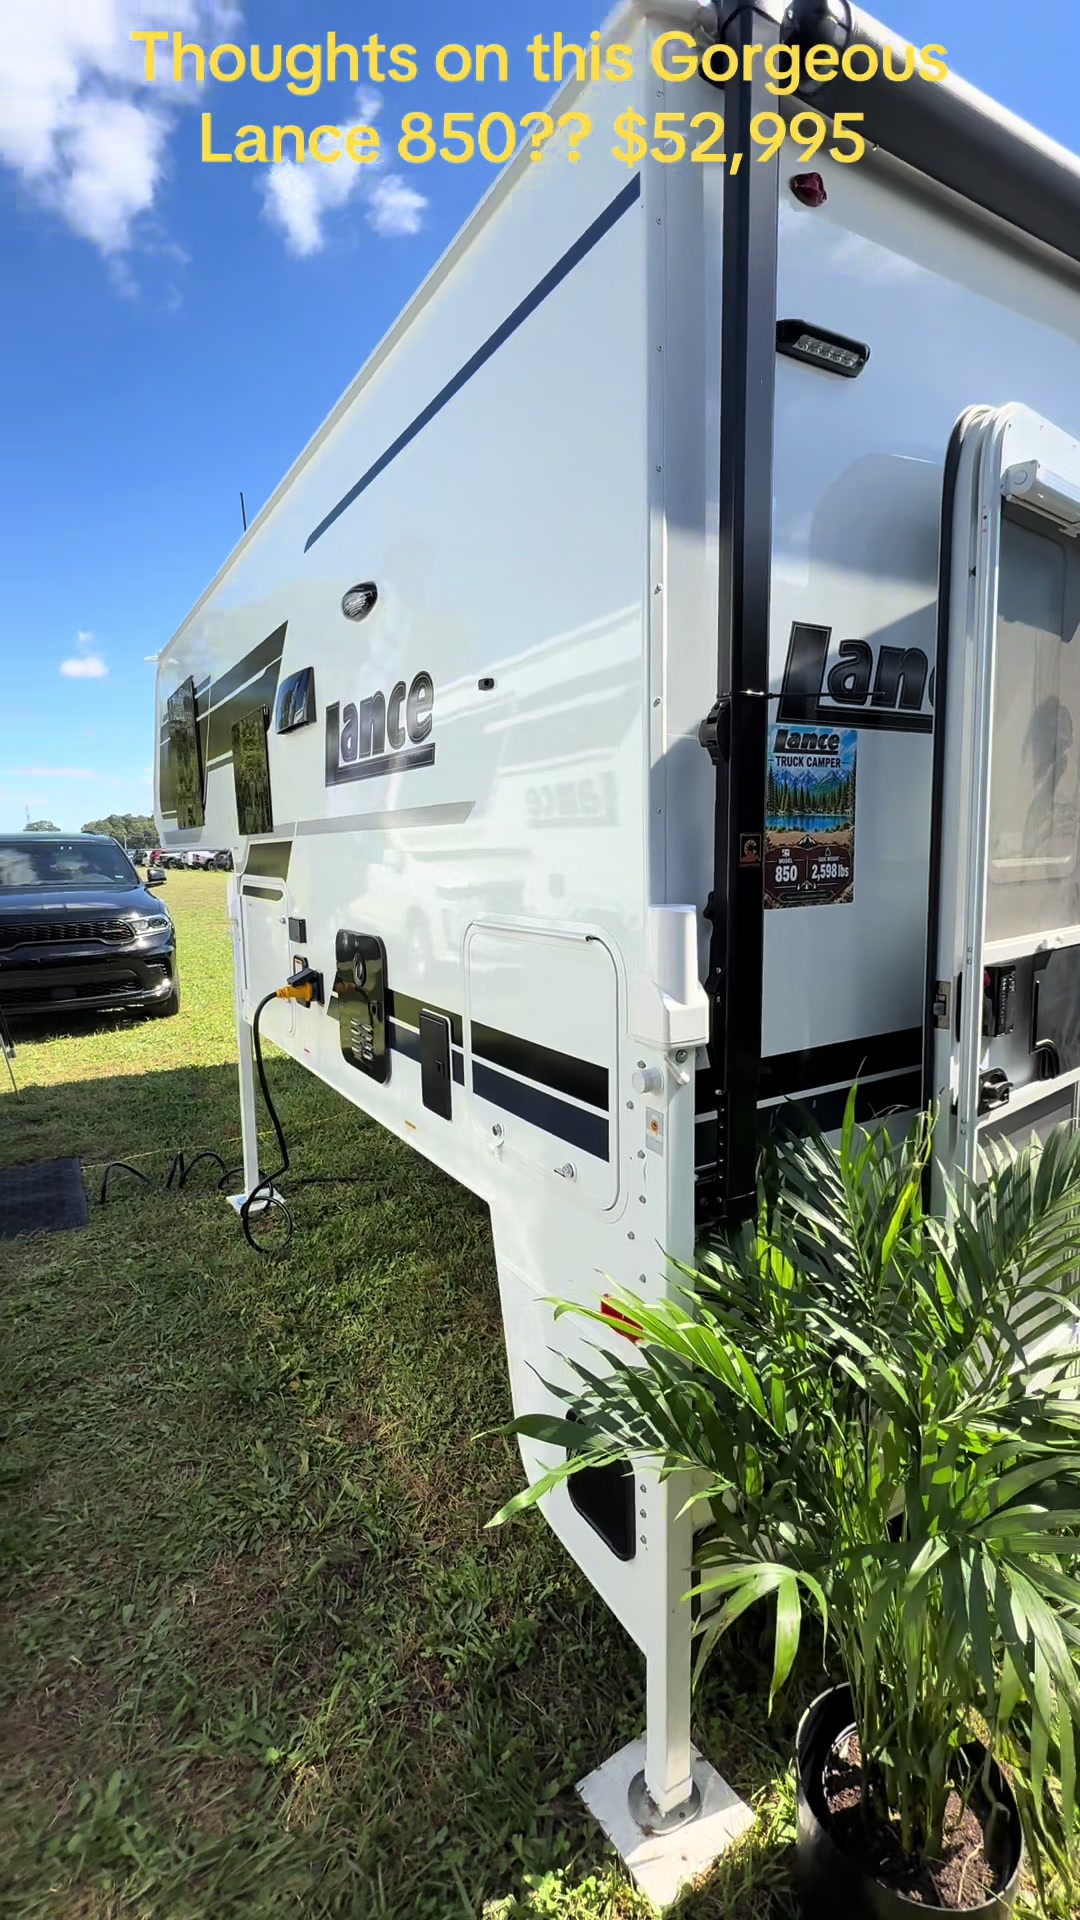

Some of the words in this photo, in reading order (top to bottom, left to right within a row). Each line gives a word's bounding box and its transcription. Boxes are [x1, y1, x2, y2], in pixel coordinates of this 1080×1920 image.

[776, 621, 935, 734] Lan
[325, 670, 436, 787] Lance
[773, 729, 840, 755] Lance
[776, 756, 804, 767] TRUCK
[806, 756, 841, 768] CAMPER
[775, 864, 798, 883] 850
[811, 863, 837, 881] 2,598
[837, 864, 849, 878] lbs
